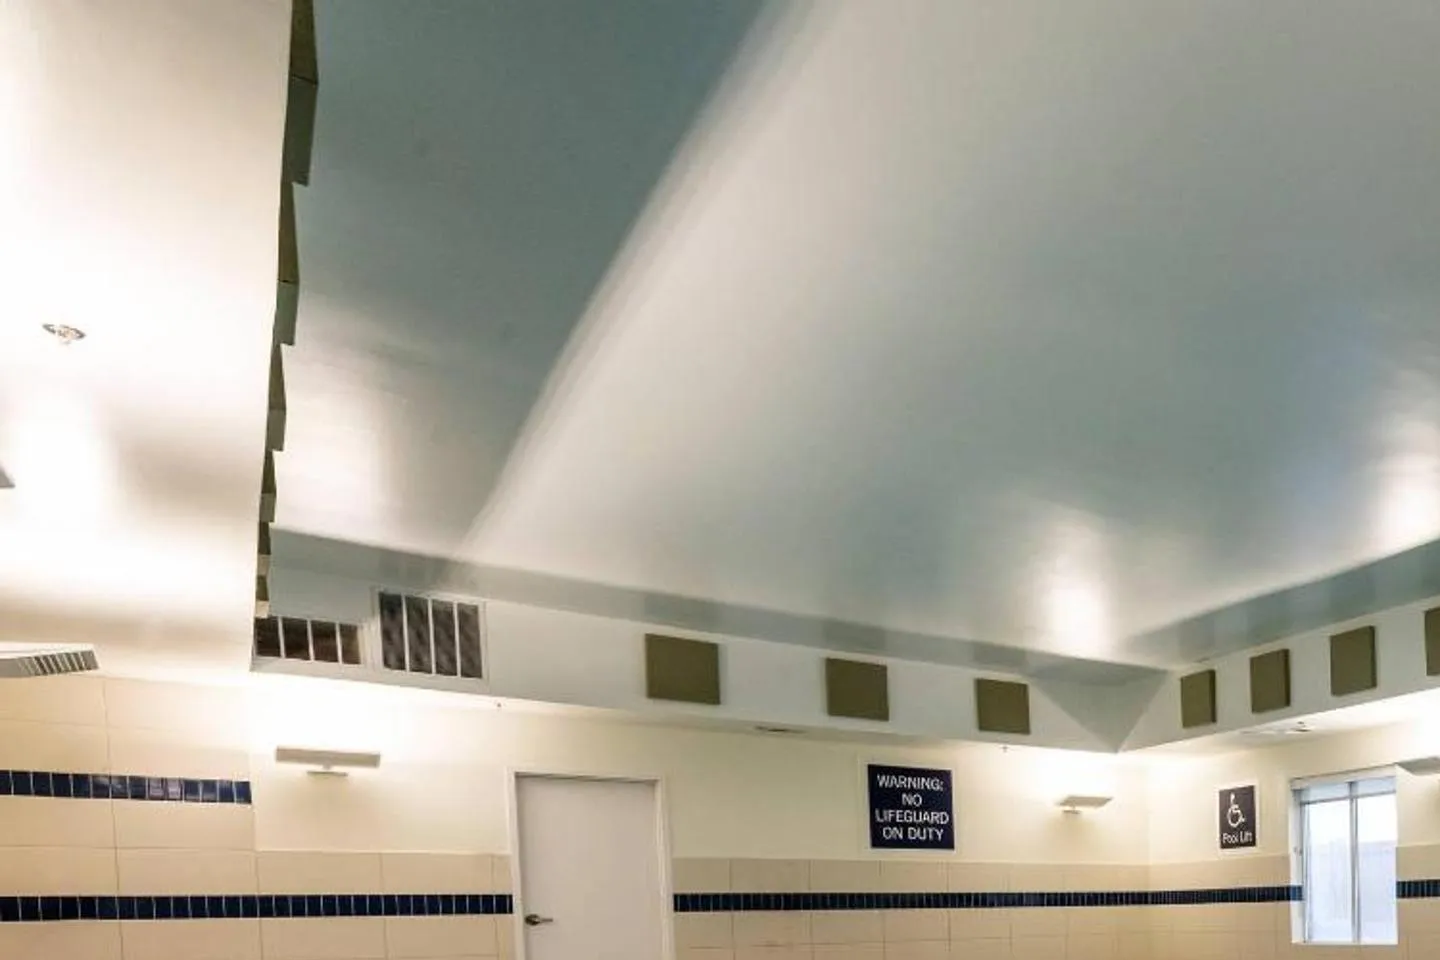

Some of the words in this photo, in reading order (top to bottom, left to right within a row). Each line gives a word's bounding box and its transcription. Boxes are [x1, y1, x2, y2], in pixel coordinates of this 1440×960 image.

[876, 774, 944, 791] WARNING:
[901, 793, 923, 807] NO
[875, 808, 950, 825] LIFEGUARD
[882, 826, 903, 840] ON
[907, 827, 944, 841] DUTY
[1222, 832, 1238, 844] Pool
